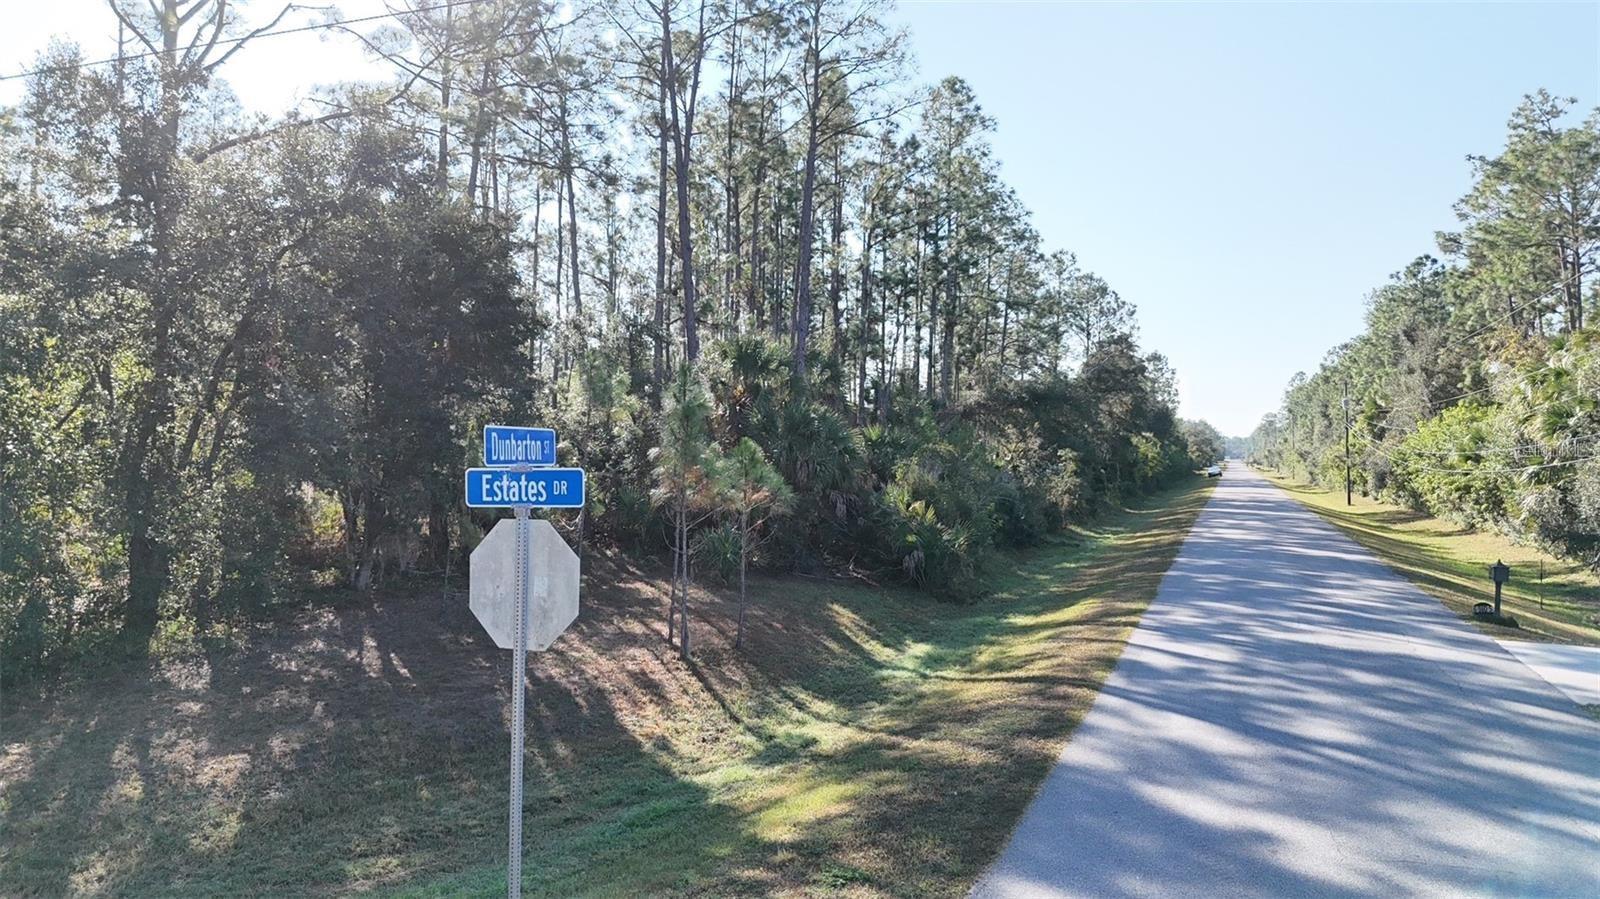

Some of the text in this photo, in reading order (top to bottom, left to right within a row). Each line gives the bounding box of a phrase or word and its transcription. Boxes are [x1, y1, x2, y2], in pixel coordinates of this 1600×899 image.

[491, 432, 542, 461] Dunbarton
[482, 474, 568, 502] Estates DR
